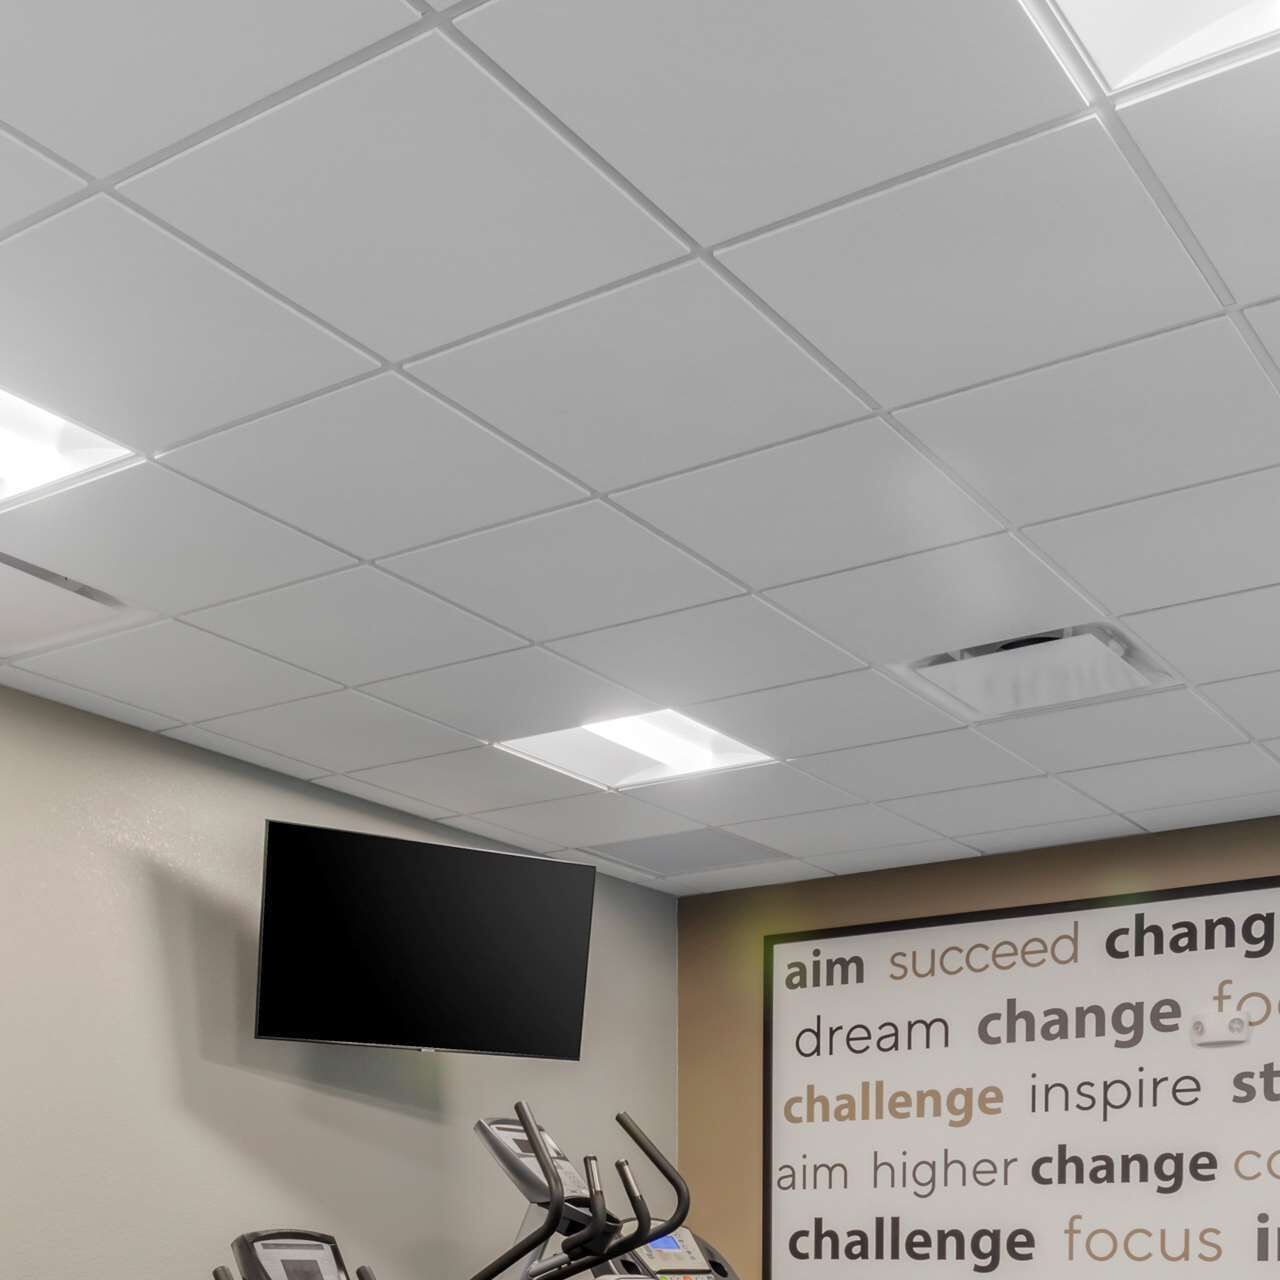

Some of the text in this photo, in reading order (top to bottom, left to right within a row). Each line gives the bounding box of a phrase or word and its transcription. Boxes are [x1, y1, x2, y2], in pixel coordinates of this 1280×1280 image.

[784, 947, 865, 990] aim
[889, 920, 1080, 981] succeed
[795, 1014, 950, 1058] dream
[977, 997, 1182, 1049] change
[783, 1079, 1004, 1128] challenge
[1030, 1066, 1202, 1123] inspire
[776, 1154, 849, 1191] aim
[872, 1147, 1019, 1199] higher
[1031, 1143, 1218, 1195] change
[788, 1216, 1036, 1274] challenge
[1063, 1214, 1223, 1263] focus
